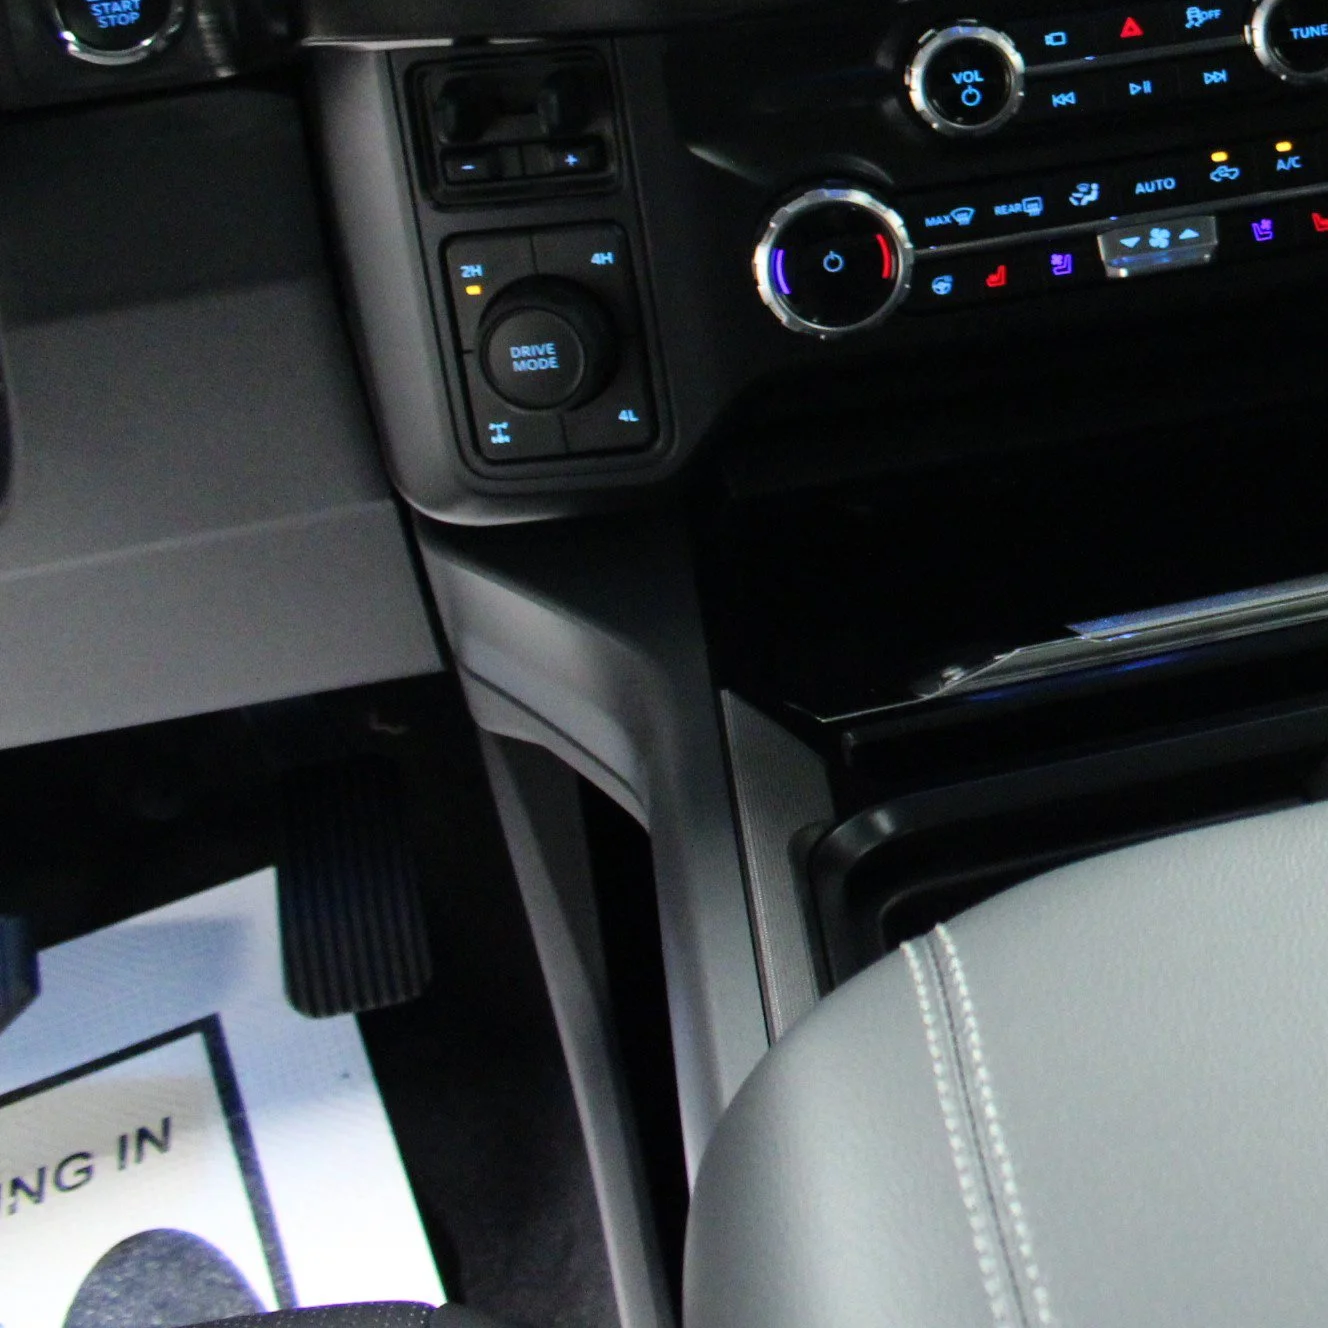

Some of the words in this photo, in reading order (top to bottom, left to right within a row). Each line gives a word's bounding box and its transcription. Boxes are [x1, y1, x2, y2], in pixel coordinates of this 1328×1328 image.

[97, 12, 140, 29] STOP
[1200, 7, 1221, 22] OFF
[1290, 23, 1328, 40] TUNE
[951, 71, 983, 85] VOL
[1276, 156, 1302, 171] A/C
[1135, 177, 1176, 195] AUTO
[994, 202, 1022, 216] REAR
[925, 215, 951, 227] MAX
[591, 251, 613, 266] 4H
[460, 264, 483, 279] 2H
[510, 343, 556, 359] DRIVE
[512, 356, 559, 372] MODE
[618, 408, 639, 423] 4L
[0, 1151, 95, 1217] NG
[117, 1116, 173, 1171] IN
